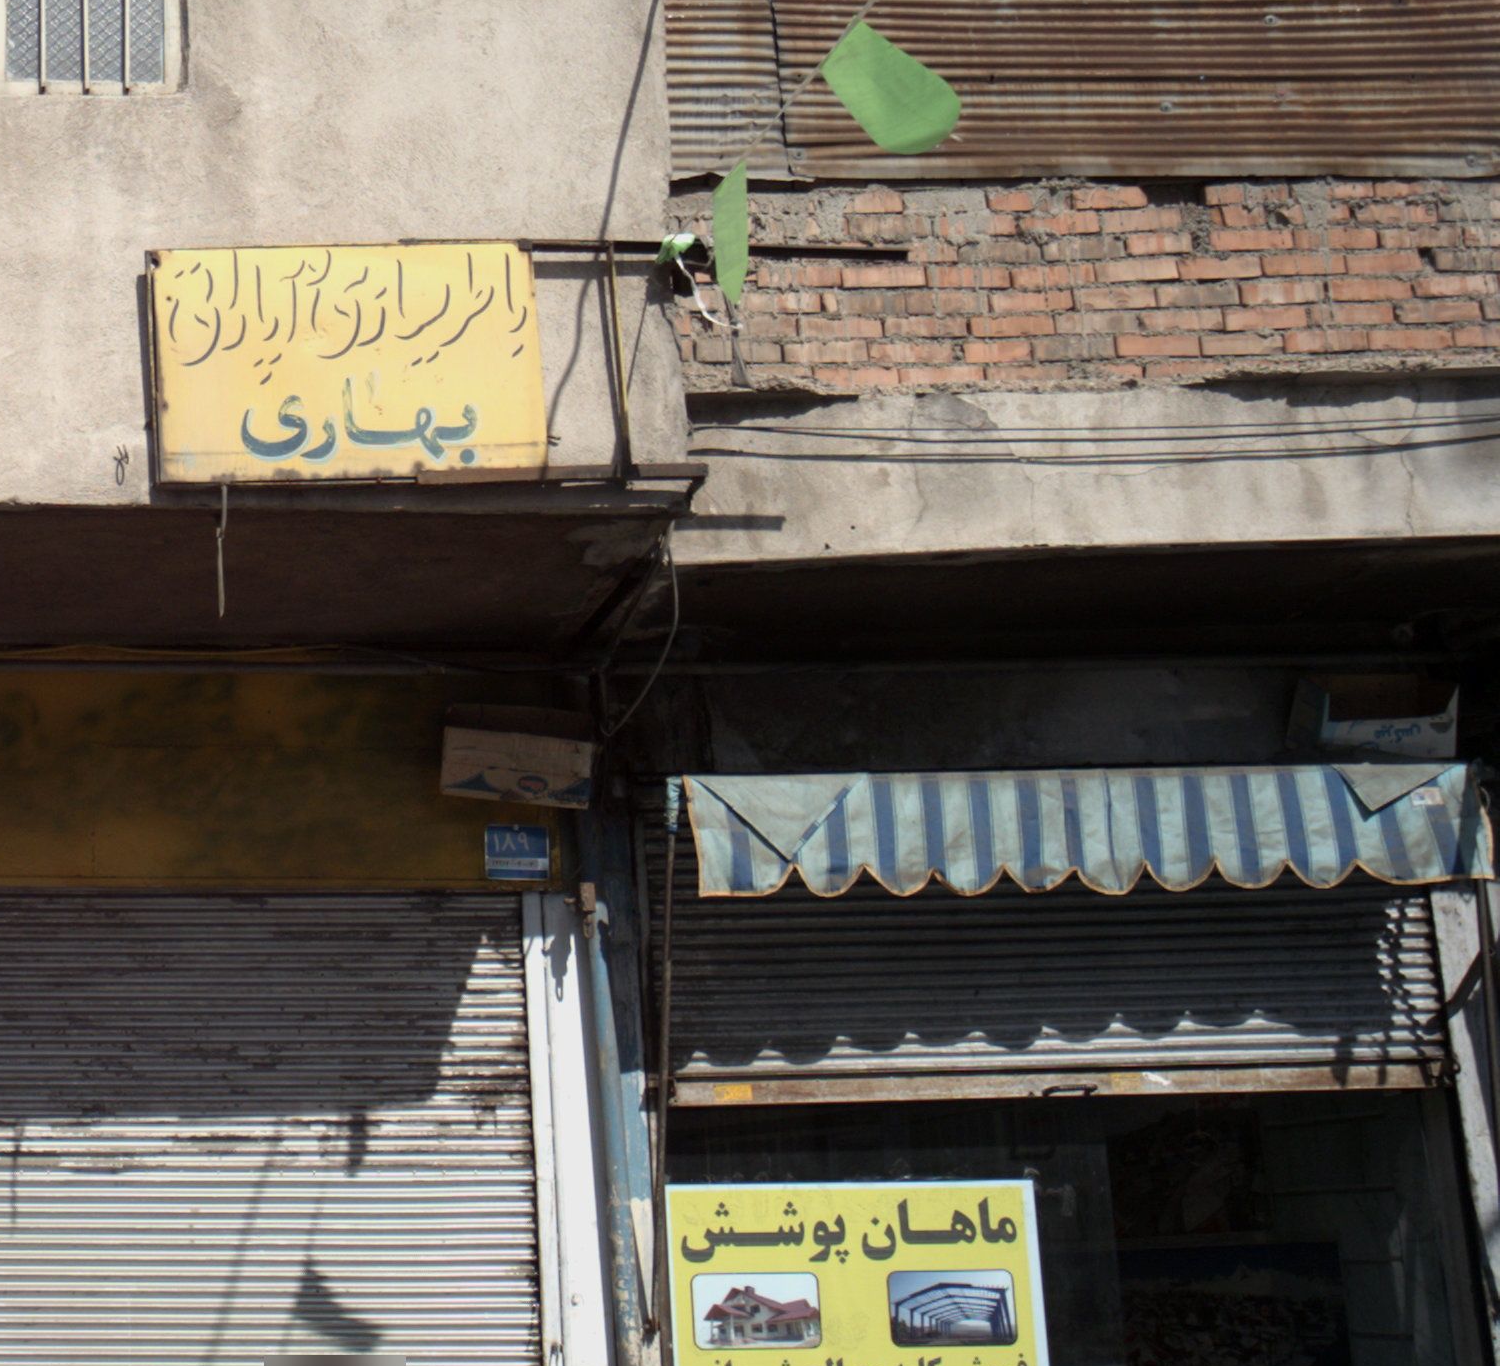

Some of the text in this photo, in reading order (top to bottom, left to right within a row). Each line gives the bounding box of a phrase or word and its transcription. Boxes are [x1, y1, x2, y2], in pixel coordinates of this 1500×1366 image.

[240, 376, 479, 465] بهاری
[493, 831, 530, 852] ۱۸۹
[681, 1196, 1018, 1264] ماهان پوشش
